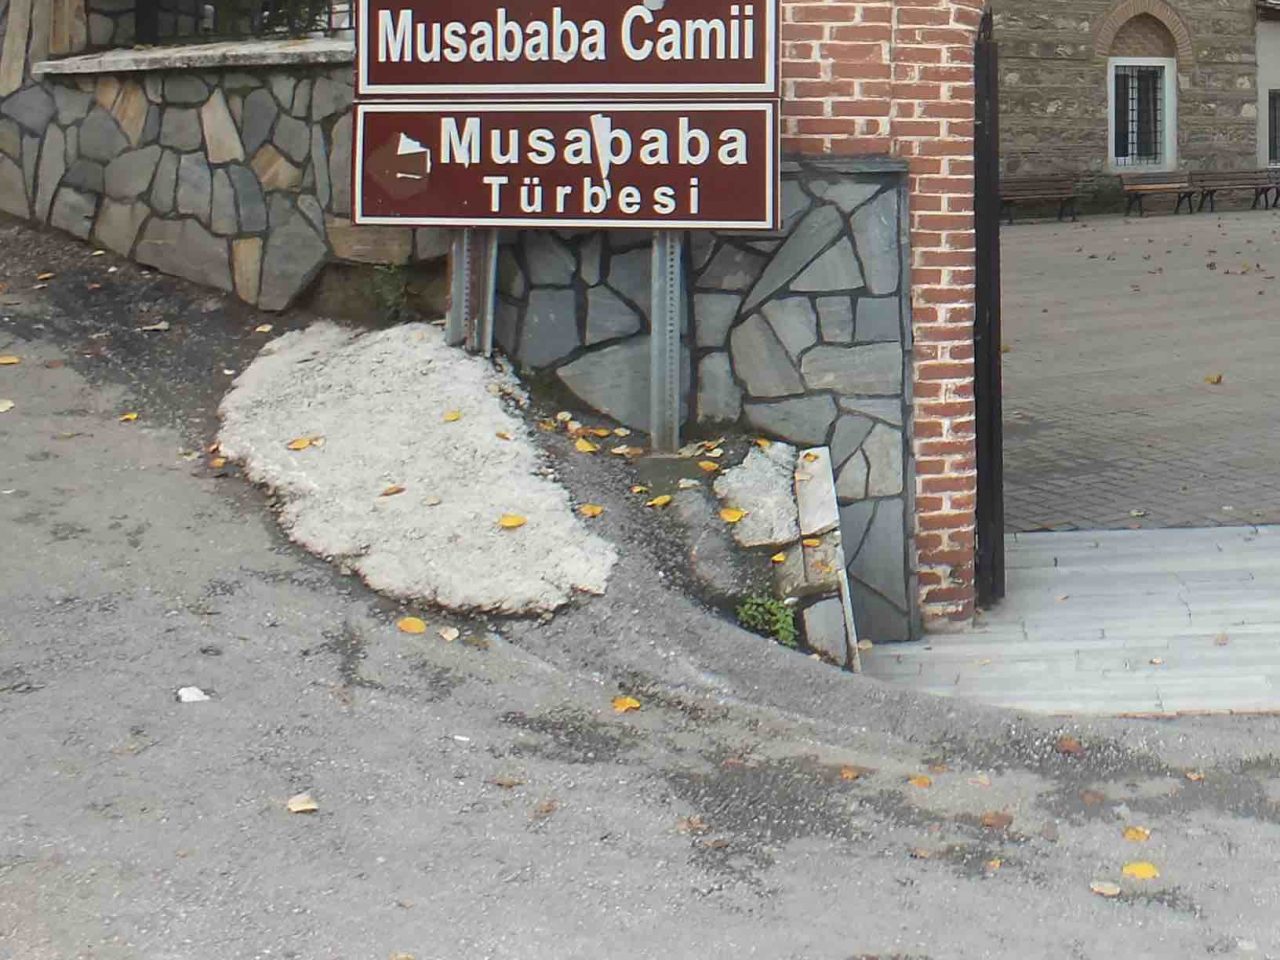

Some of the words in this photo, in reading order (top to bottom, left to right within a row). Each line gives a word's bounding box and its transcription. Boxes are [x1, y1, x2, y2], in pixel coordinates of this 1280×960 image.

[377, 7, 606, 63] Musababa
[621, 4, 754, 62] Camii
[440, 116, 749, 167] Musababa
[483, 177, 700, 214] Türbesi
